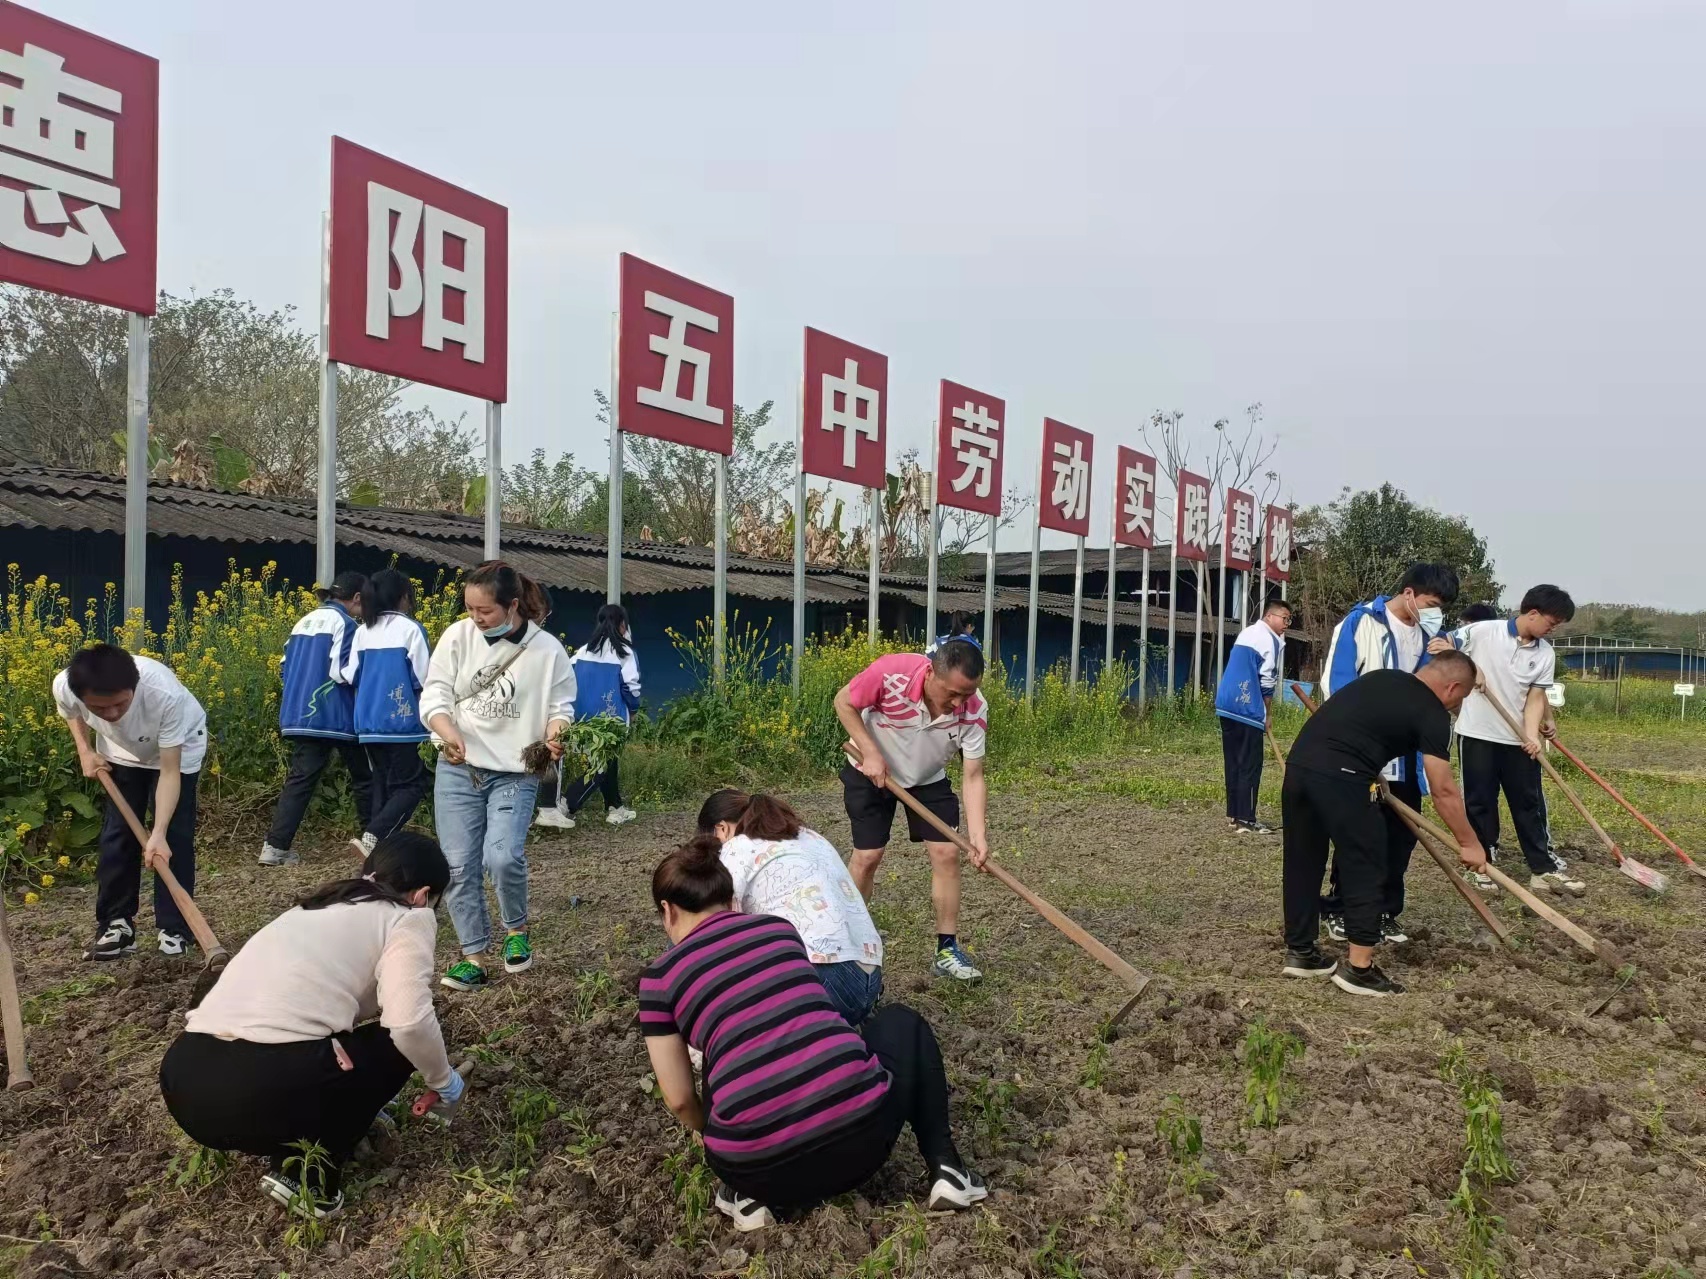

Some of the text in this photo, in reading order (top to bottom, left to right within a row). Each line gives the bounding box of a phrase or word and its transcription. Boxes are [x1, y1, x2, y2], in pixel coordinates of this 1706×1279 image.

[366, 181, 485, 363] 阳
[637, 291, 723, 424] 五
[821, 358, 879, 468] 中
[952, 401, 999, 497] 劳
[1052, 440, 1088, 519] 动
[1123, 462, 1154, 538] 实
[1183, 484, 1207, 552] 践
[1231, 499, 1251, 561] 基
[1270, 516, 1290, 572] 地
